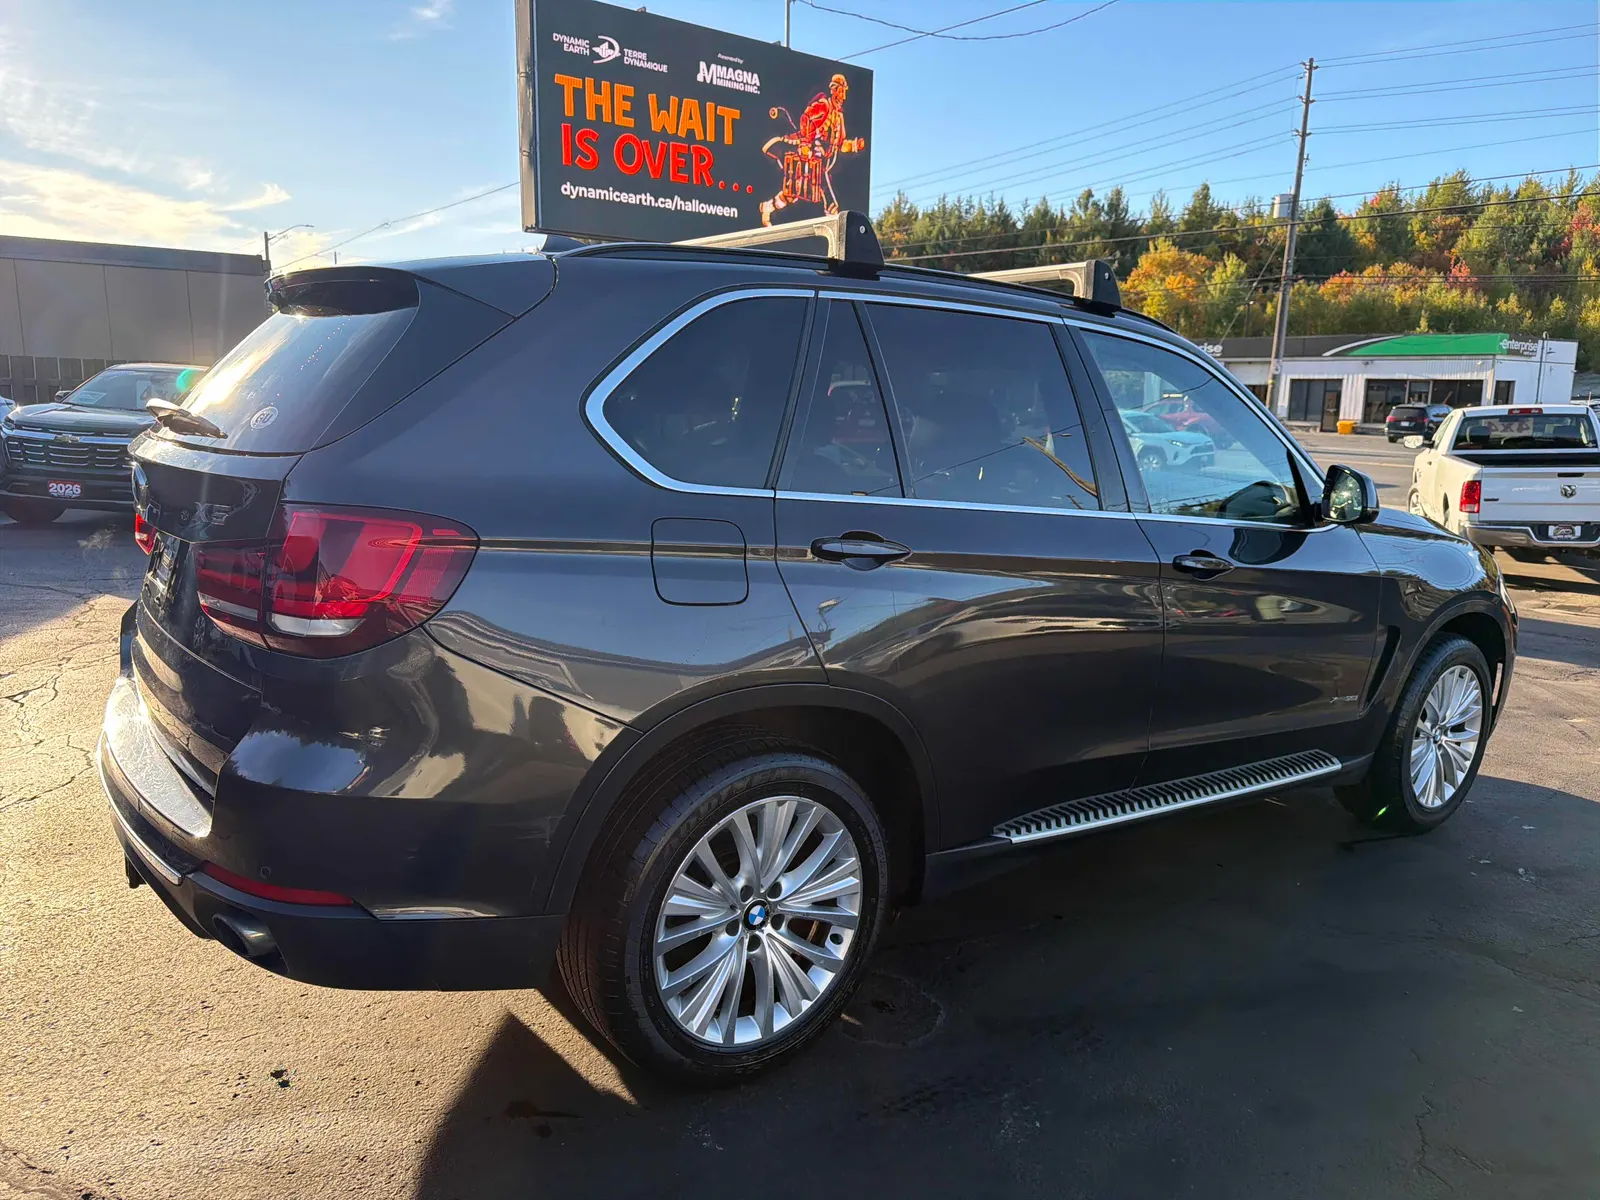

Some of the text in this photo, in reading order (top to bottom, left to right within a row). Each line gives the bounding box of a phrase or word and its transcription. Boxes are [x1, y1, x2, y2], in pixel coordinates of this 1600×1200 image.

[552, 32, 590, 48] DYNAMIC
[563, 43, 590, 56] EARTH
[623, 48, 647, 60] TERRE
[623, 56, 668, 73] DYNAMIQUE
[716, 64, 760, 87] MAGNA
[716, 78, 760, 95] MINING INC.
[554, 73, 741, 145] THE WAIT
[561, 123, 600, 170] IS
[560, 181, 738, 218] dynamicearth.ca/halloween
[1502, 338, 1538, 353] enterprise
[49, 482, 81, 495] 2026
[192, 501, 231, 525] X5
